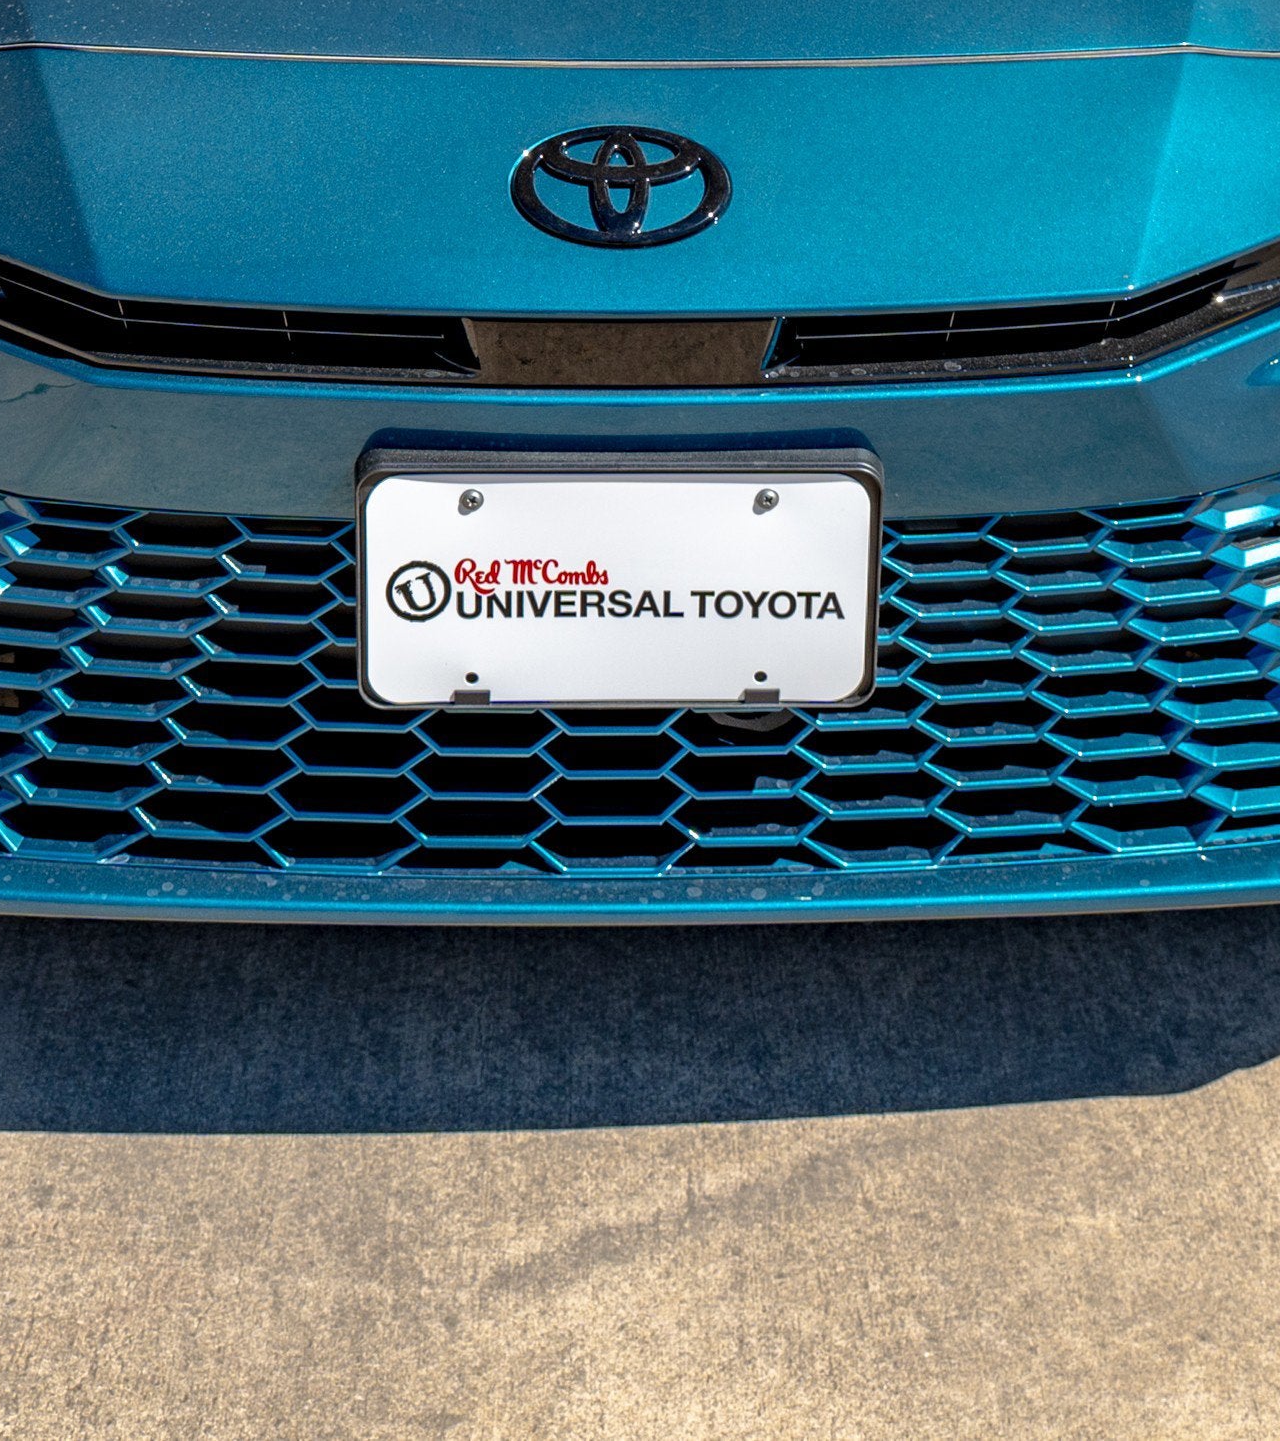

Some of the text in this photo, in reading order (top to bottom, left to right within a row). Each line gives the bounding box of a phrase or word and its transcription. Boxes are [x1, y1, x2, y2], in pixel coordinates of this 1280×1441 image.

[454, 558, 609, 595] Red McCombs
[456, 589, 846, 620] UNIVERSAL TOYOTA
